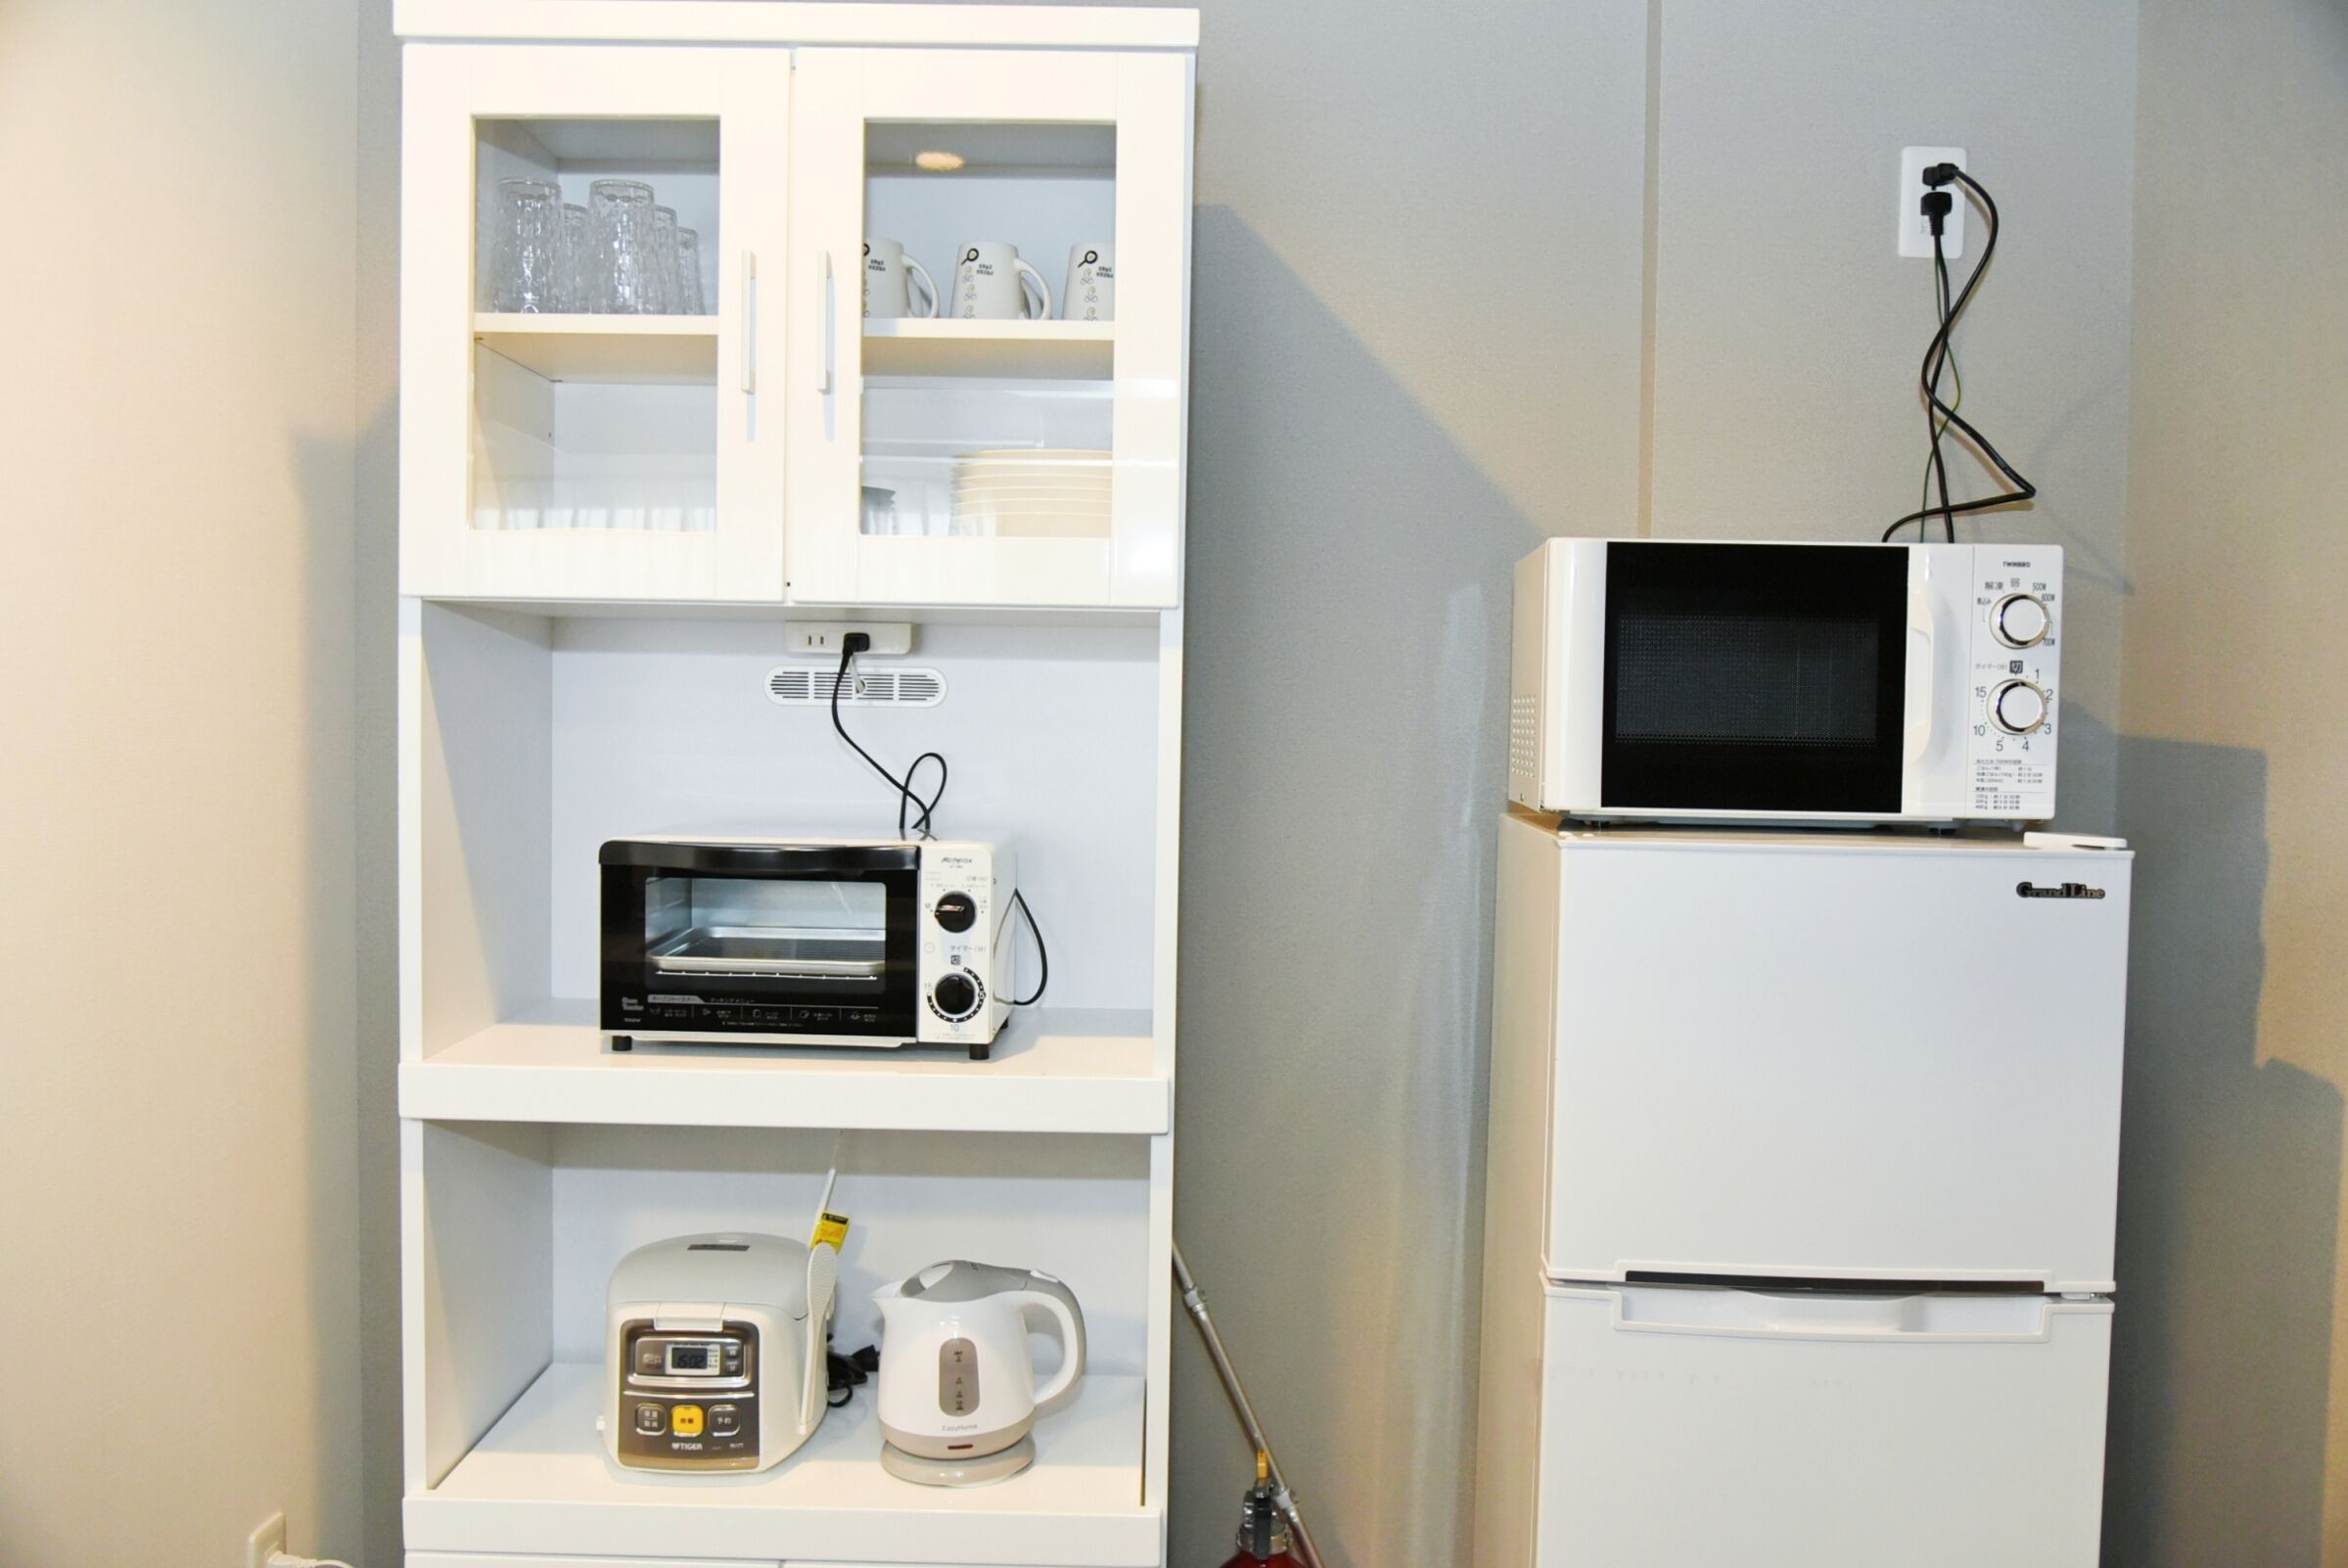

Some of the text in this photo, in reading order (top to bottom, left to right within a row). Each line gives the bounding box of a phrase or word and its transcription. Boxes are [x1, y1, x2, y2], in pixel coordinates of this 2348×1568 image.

[2032, 582, 2047, 591] 500W
[2041, 593, 2055, 602] 600W
[2011, 661, 2022, 673] 切
[2035, 669, 2040, 679] 1
[1975, 686, 1987, 698] 15
[2046, 688, 2053, 701] 2
[1973, 724, 1986, 737] 10
[2044, 722, 2051, 735] 3
[1996, 740, 2003, 752] 5
[2022, 740, 2030, 752] 4
[924, 983, 933, 992] 15
